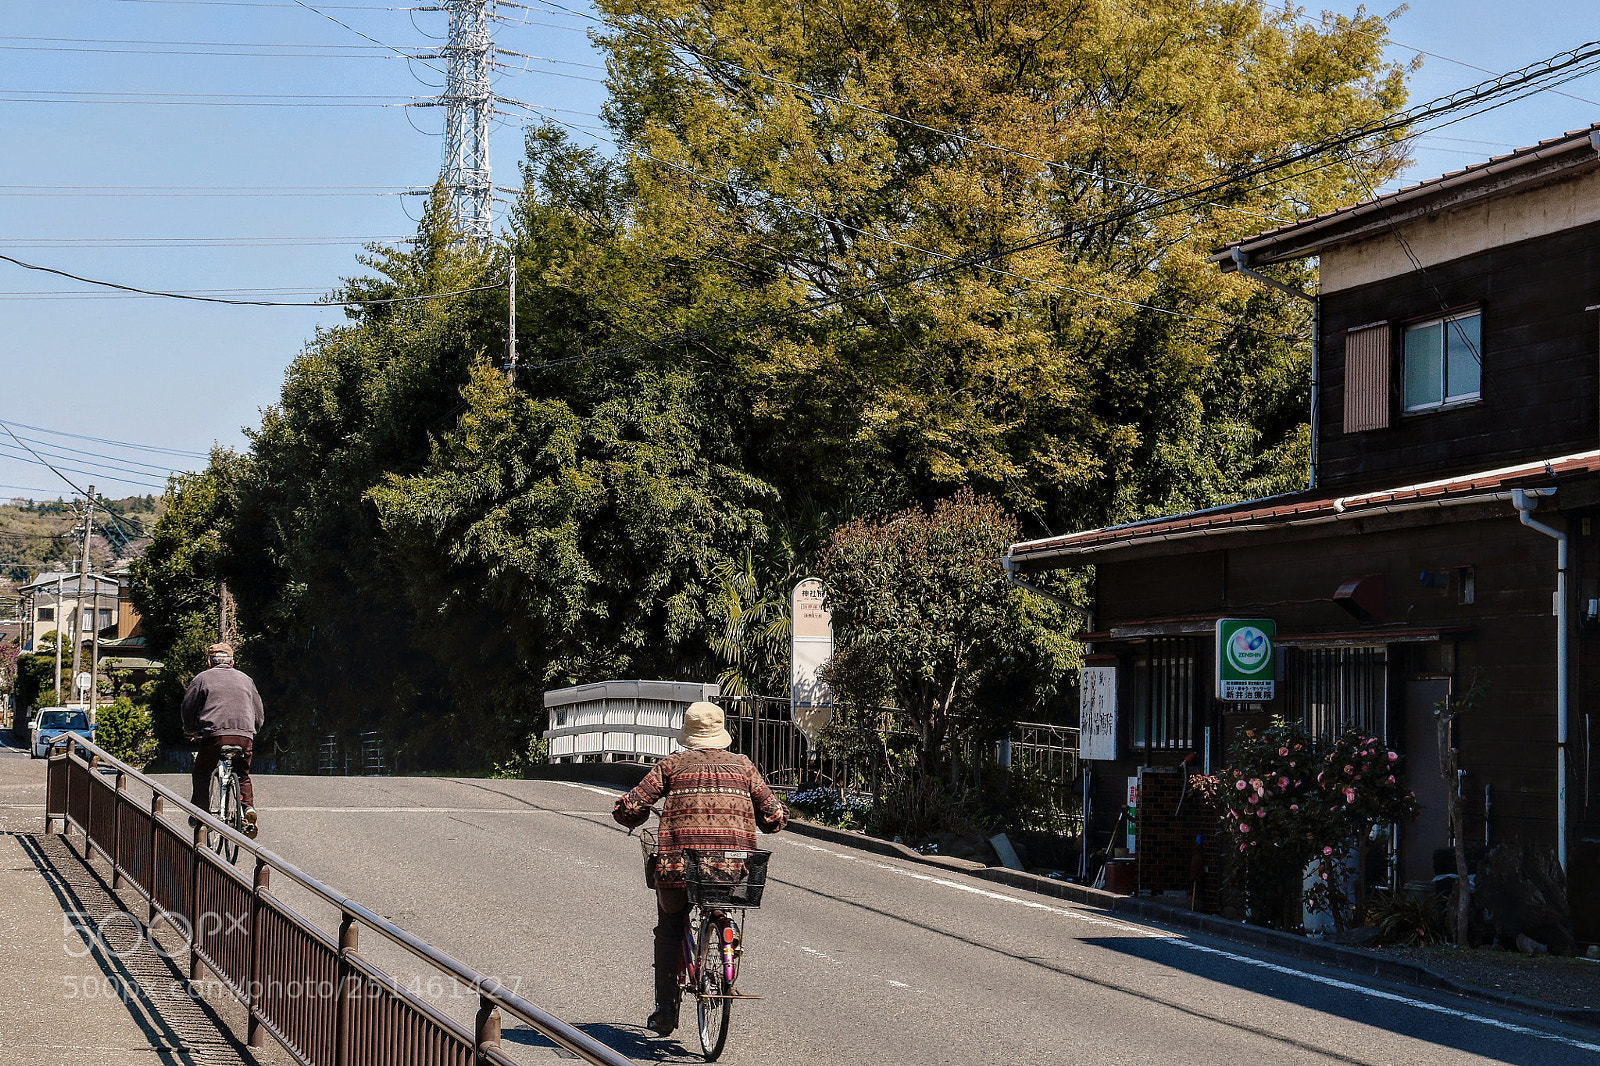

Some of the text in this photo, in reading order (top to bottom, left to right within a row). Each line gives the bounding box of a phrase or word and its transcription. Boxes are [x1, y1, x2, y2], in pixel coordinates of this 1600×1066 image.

[1226, 691, 1272, 699] 新井治療院
